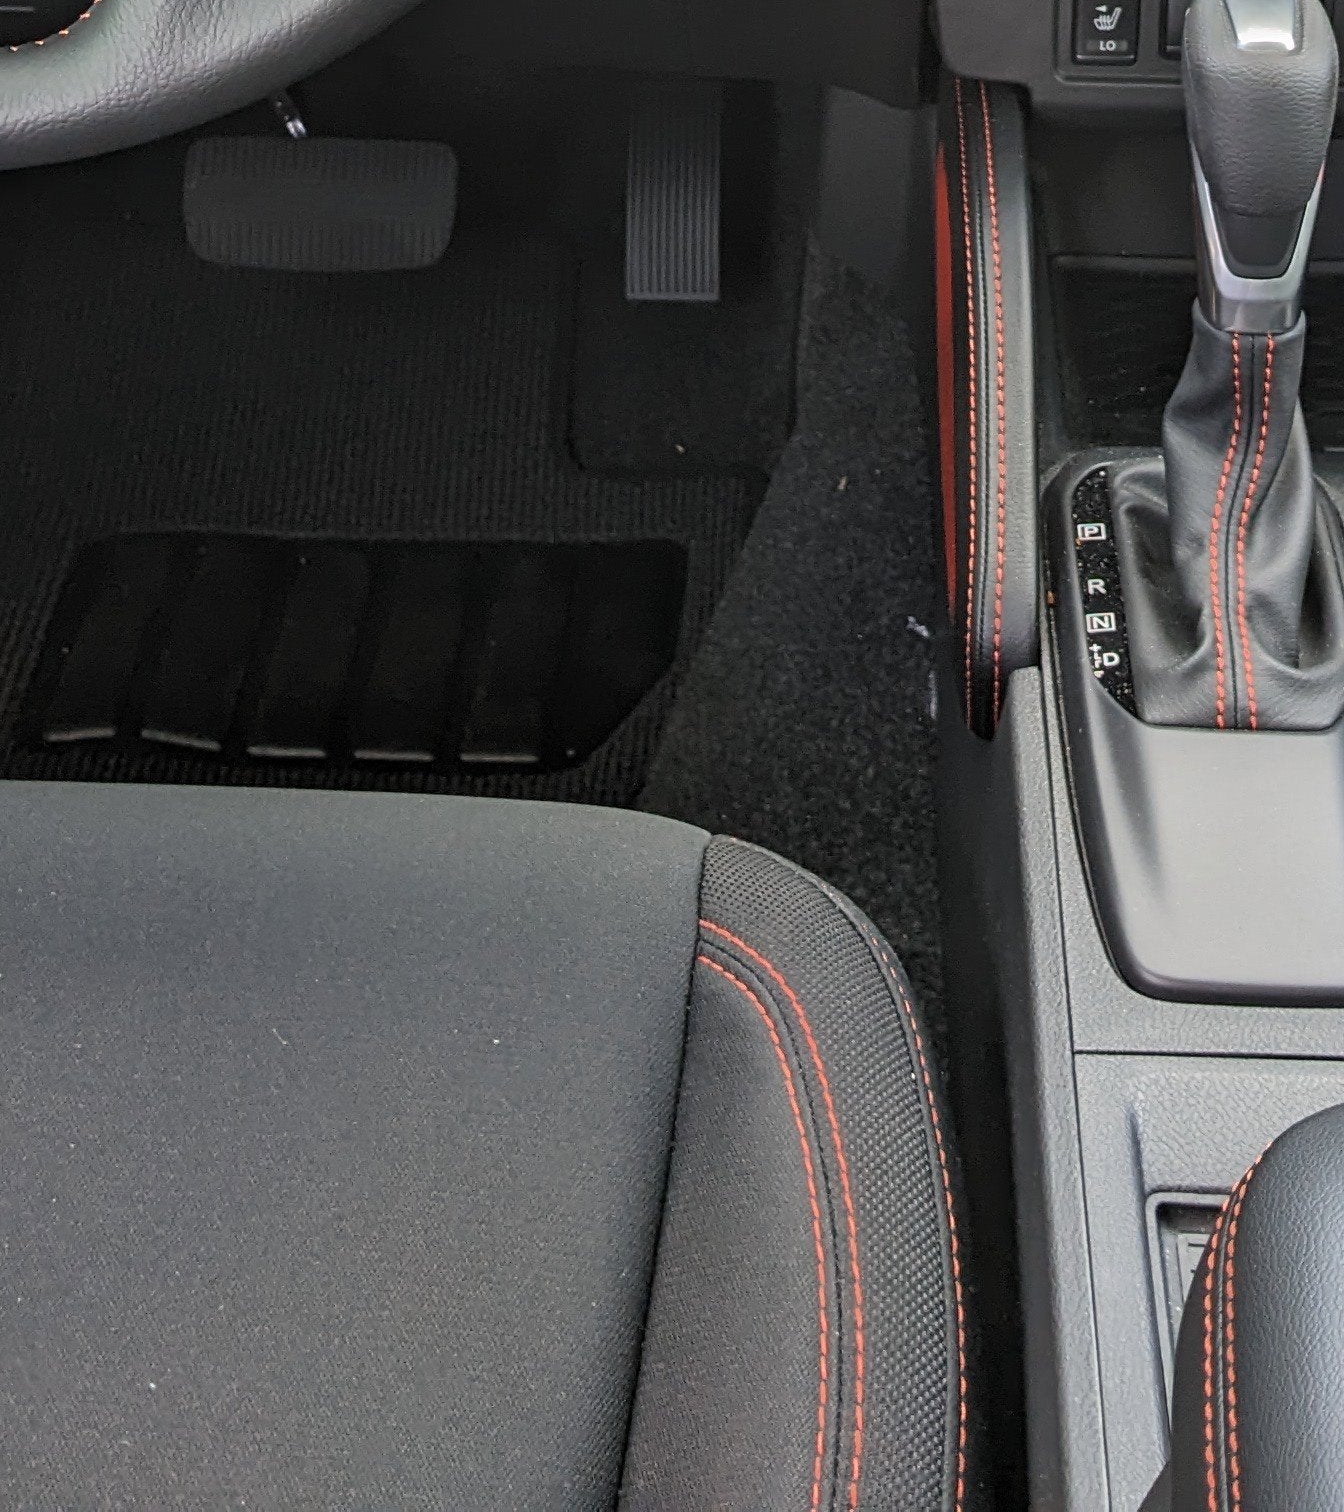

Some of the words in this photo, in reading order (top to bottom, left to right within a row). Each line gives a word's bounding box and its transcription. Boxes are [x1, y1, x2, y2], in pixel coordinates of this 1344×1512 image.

[1099, 40, 1116, 52] LO
[1087, 578, 1107, 595] R
[1102, 652, 1121, 667] D
